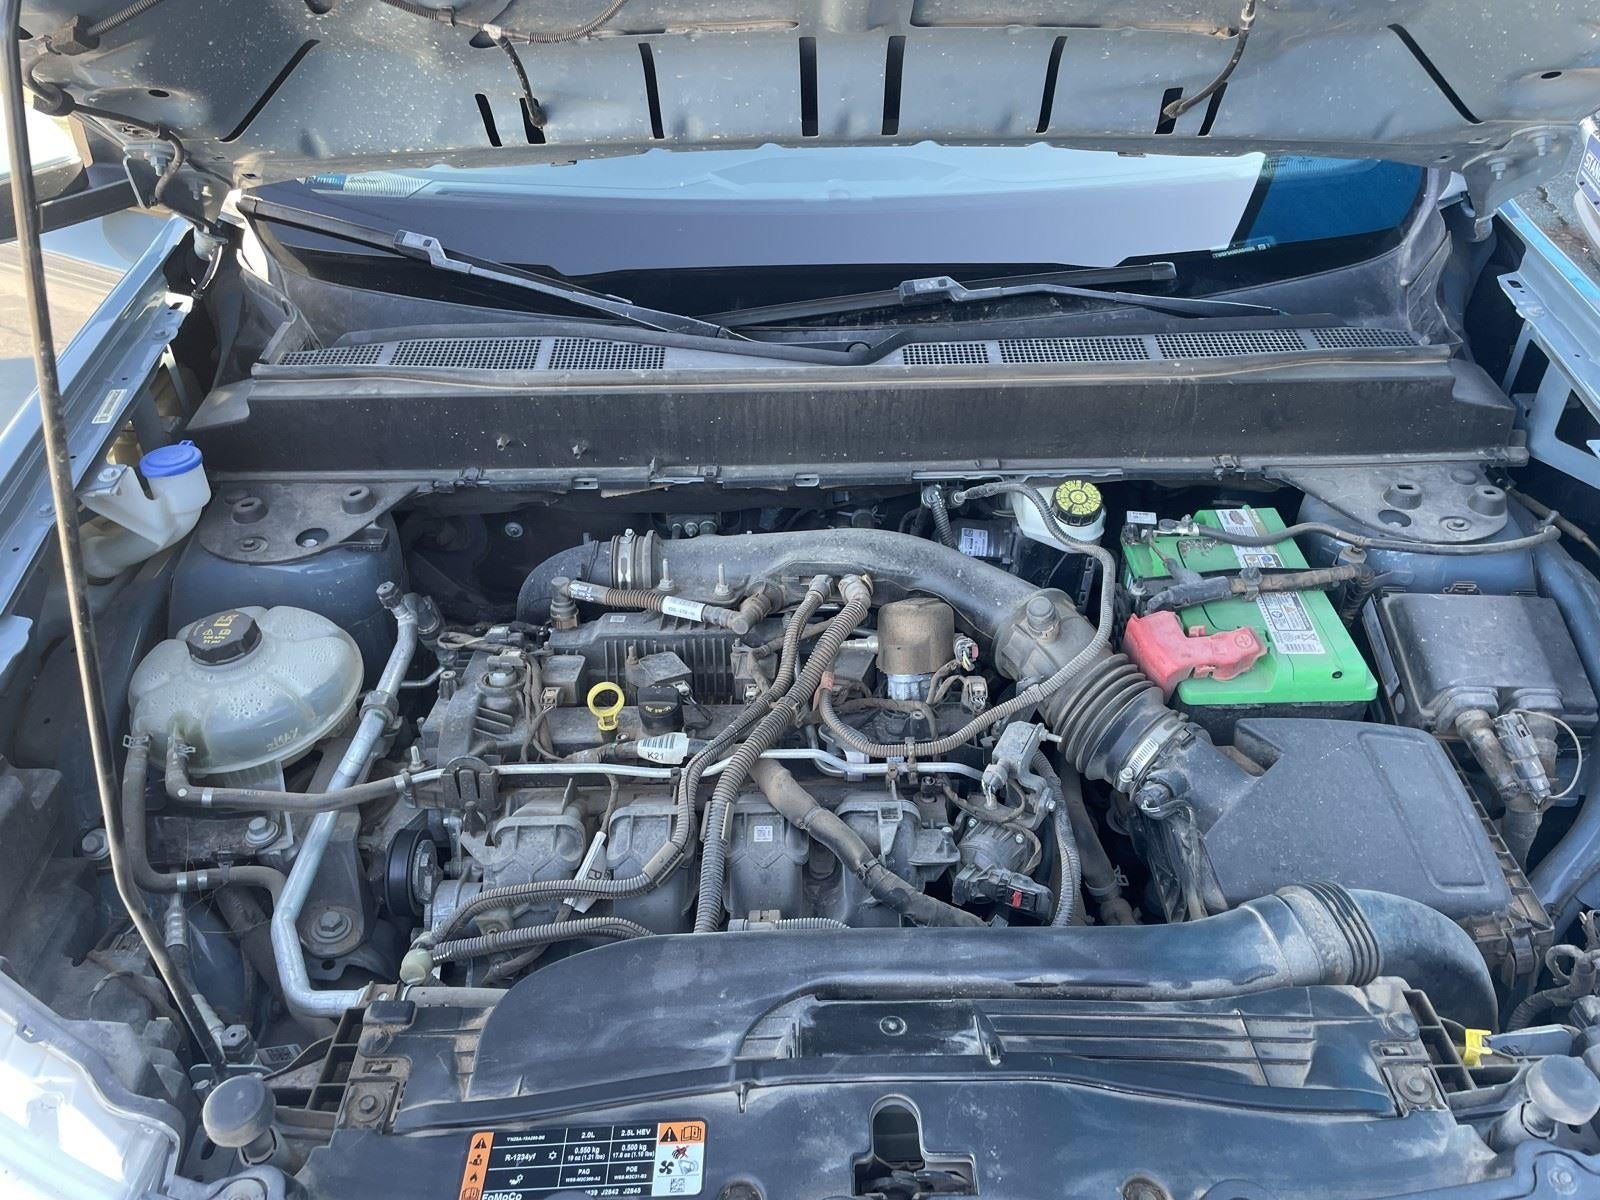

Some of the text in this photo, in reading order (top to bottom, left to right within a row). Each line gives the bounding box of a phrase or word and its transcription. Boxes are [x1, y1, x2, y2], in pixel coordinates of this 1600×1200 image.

[647, 751, 664, 761] K21
[581, 1131, 595, 1139] 2.0L
[621, 1128, 651, 1137] 2.5L HEV
[592, 1146, 600, 1156] kg
[639, 1143, 647, 1153] kg
[504, 1152, 537, 1162] R-1234yf
[482, 1192, 523, 1200] FoMoCo
